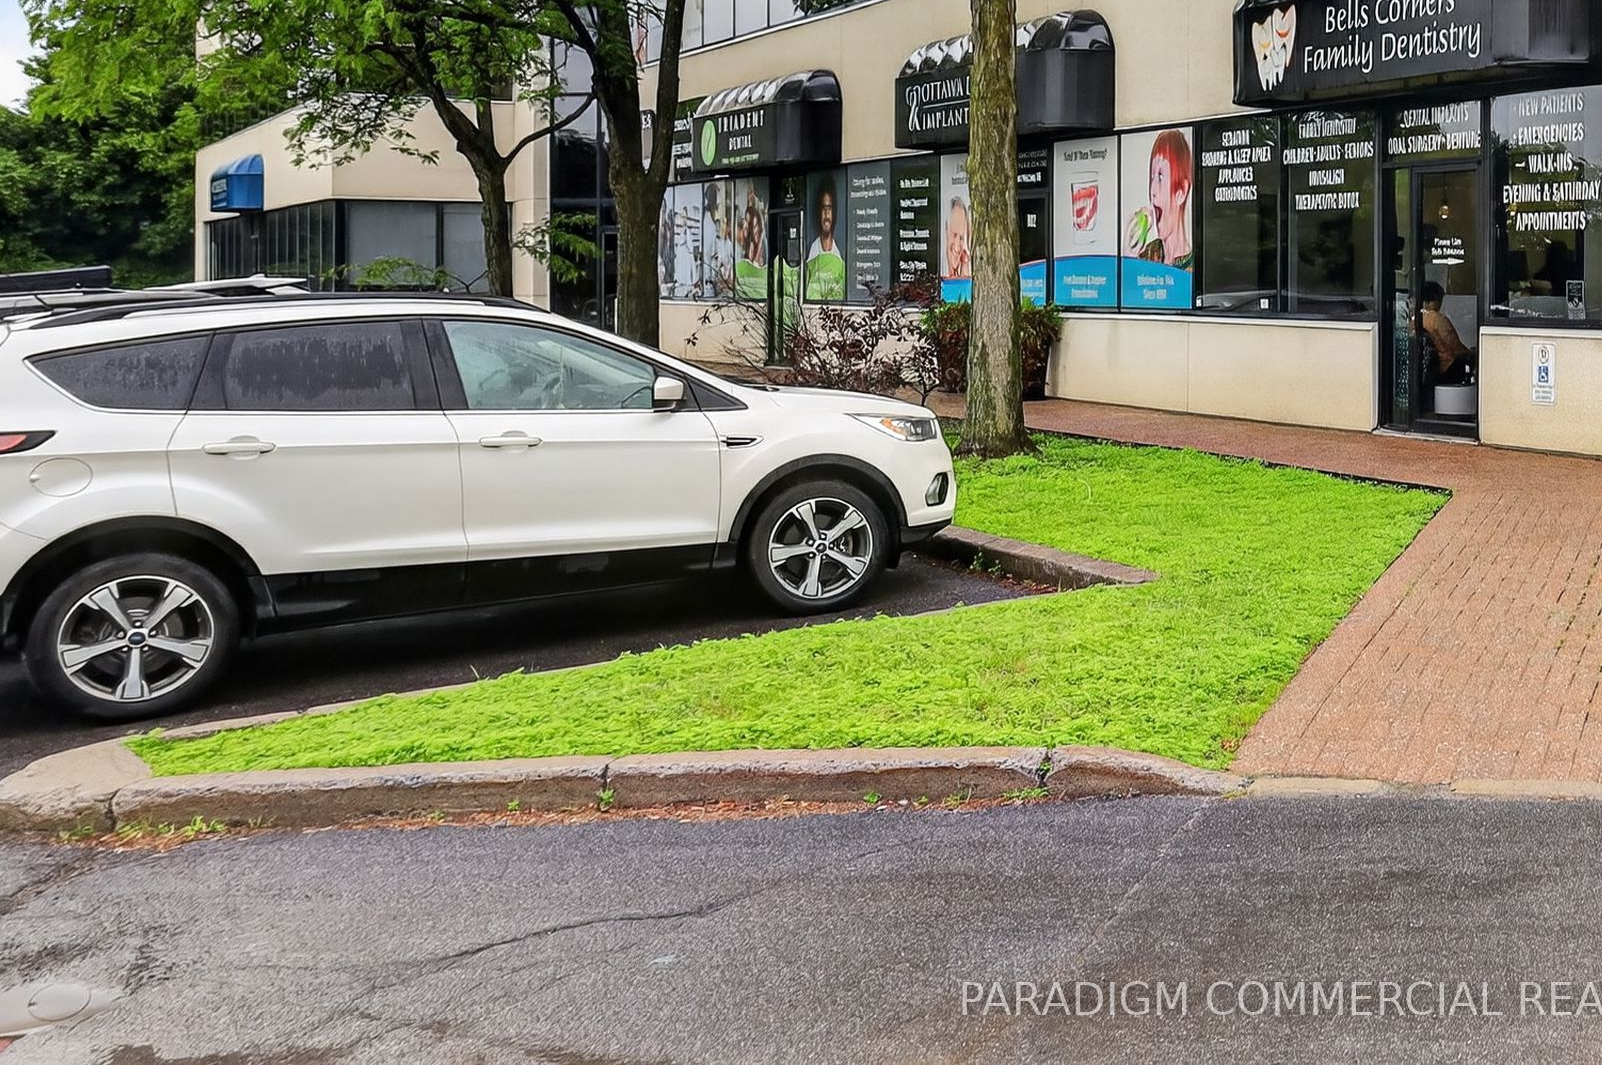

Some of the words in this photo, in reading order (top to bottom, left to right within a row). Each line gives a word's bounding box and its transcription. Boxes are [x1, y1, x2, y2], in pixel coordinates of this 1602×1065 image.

[1304, 35, 1373, 73] Family
[1381, 21, 1481, 61] Dentistry
[922, 77, 964, 102] OTTAWA
[1519, 96, 1538, 116] NEW
[1541, 93, 1584, 113] PATIENTS
[718, 109, 764, 133] TRIADENT
[1518, 122, 1584, 145] EMERGENCIES
[1528, 152, 1573, 173] WALK-INS
[1504, 185, 1541, 203] EVENING
[1543, 185, 1550, 201] &
[1552, 180, 1600, 202] SATURDAY
[1516, 211, 1586, 231] APPOINTMENTS
